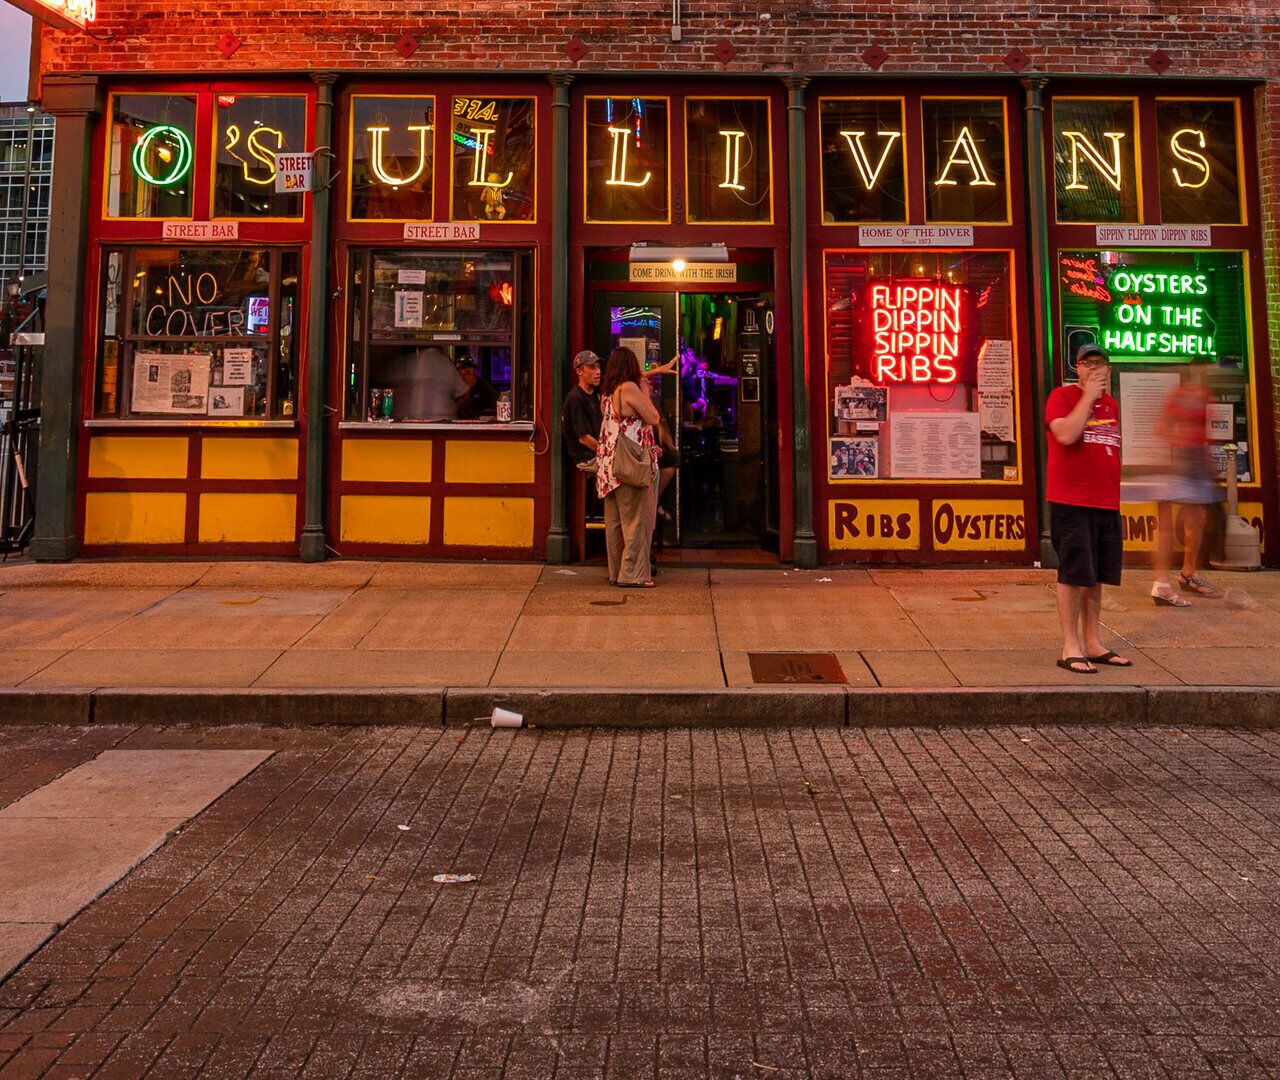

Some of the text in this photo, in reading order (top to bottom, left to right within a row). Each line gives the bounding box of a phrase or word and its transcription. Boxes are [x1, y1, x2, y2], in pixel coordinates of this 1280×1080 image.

[279, 156, 312, 171] STREET
[285, 173, 306, 190] BAR
[166, 224, 235, 237] STREET BAR
[407, 226, 476, 239] STREET BAR
[861, 228, 970, 238] HOME OF THE DIVER
[1190, 230, 1208, 242] RIBS
[632, 267, 653, 278] COME
[700, 268, 714, 278] THE
[715, 268, 735, 279] IRISH
[1114, 272, 1208, 295] OYSTERS
[168, 272, 218, 307] NO
[872, 286, 960, 311] FLIPPIN
[146, 304, 244, 337] COVER
[874, 309, 960, 333] DIPPIN
[1117, 304, 1203, 328] ON THE
[875, 332, 959, 356] SIPPIN
[877, 355, 958, 383] RIBS
[834, 502, 912, 540] RIBS
[934, 502, 1026, 545] OYSTERS
